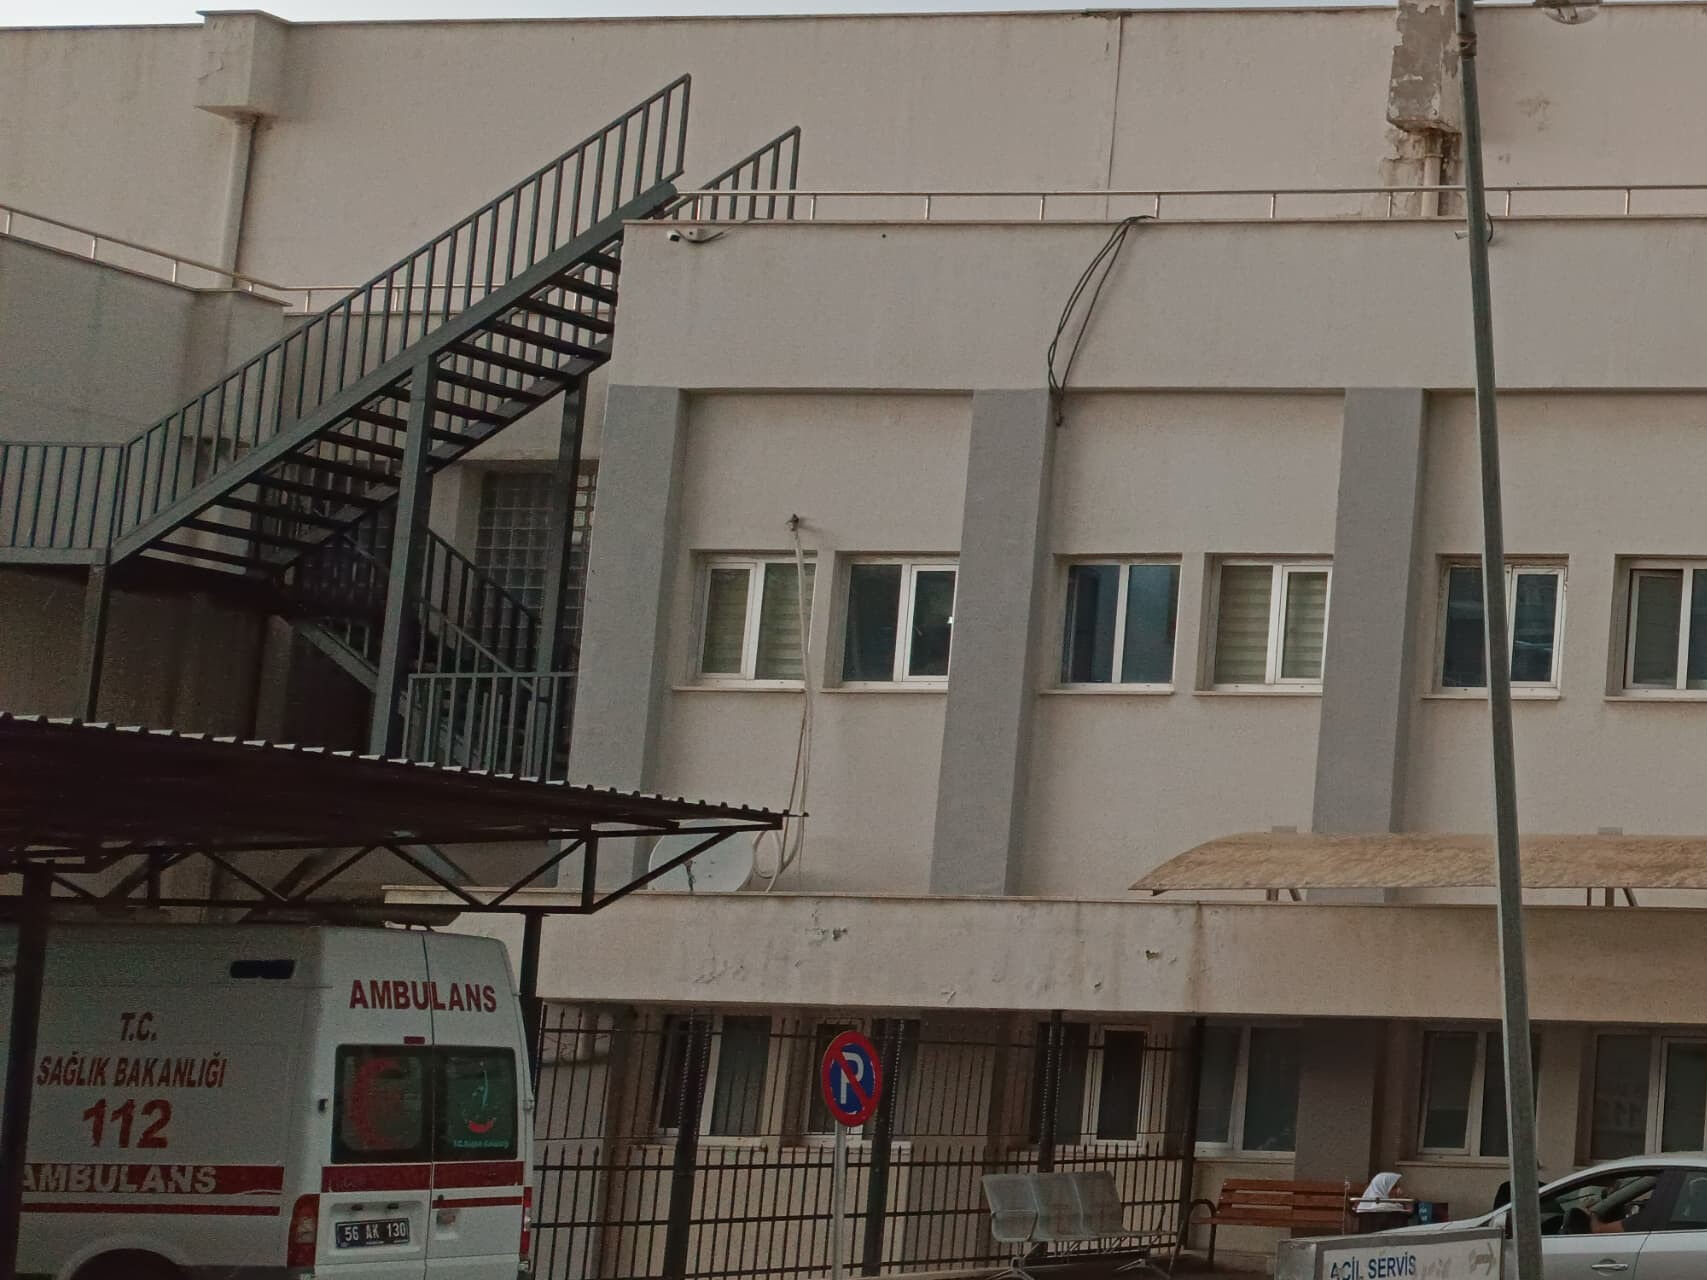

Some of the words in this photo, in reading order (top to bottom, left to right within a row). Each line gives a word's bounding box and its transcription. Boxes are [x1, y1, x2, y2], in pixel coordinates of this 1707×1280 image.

[349, 979, 497, 1013] AMBULANS
[119, 1012, 157, 1041] T.C.
[37, 1051, 110, 1087] SAĞLIK
[113, 1051, 228, 1088] BAKANLIĞI
[83, 1098, 173, 1149] 112
[344, 1226, 359, 1241] 56
[366, 1224, 379, 1239] AK
[387, 1222, 406, 1238] 130
[1368, 1252, 1416, 1280] SERVİS
